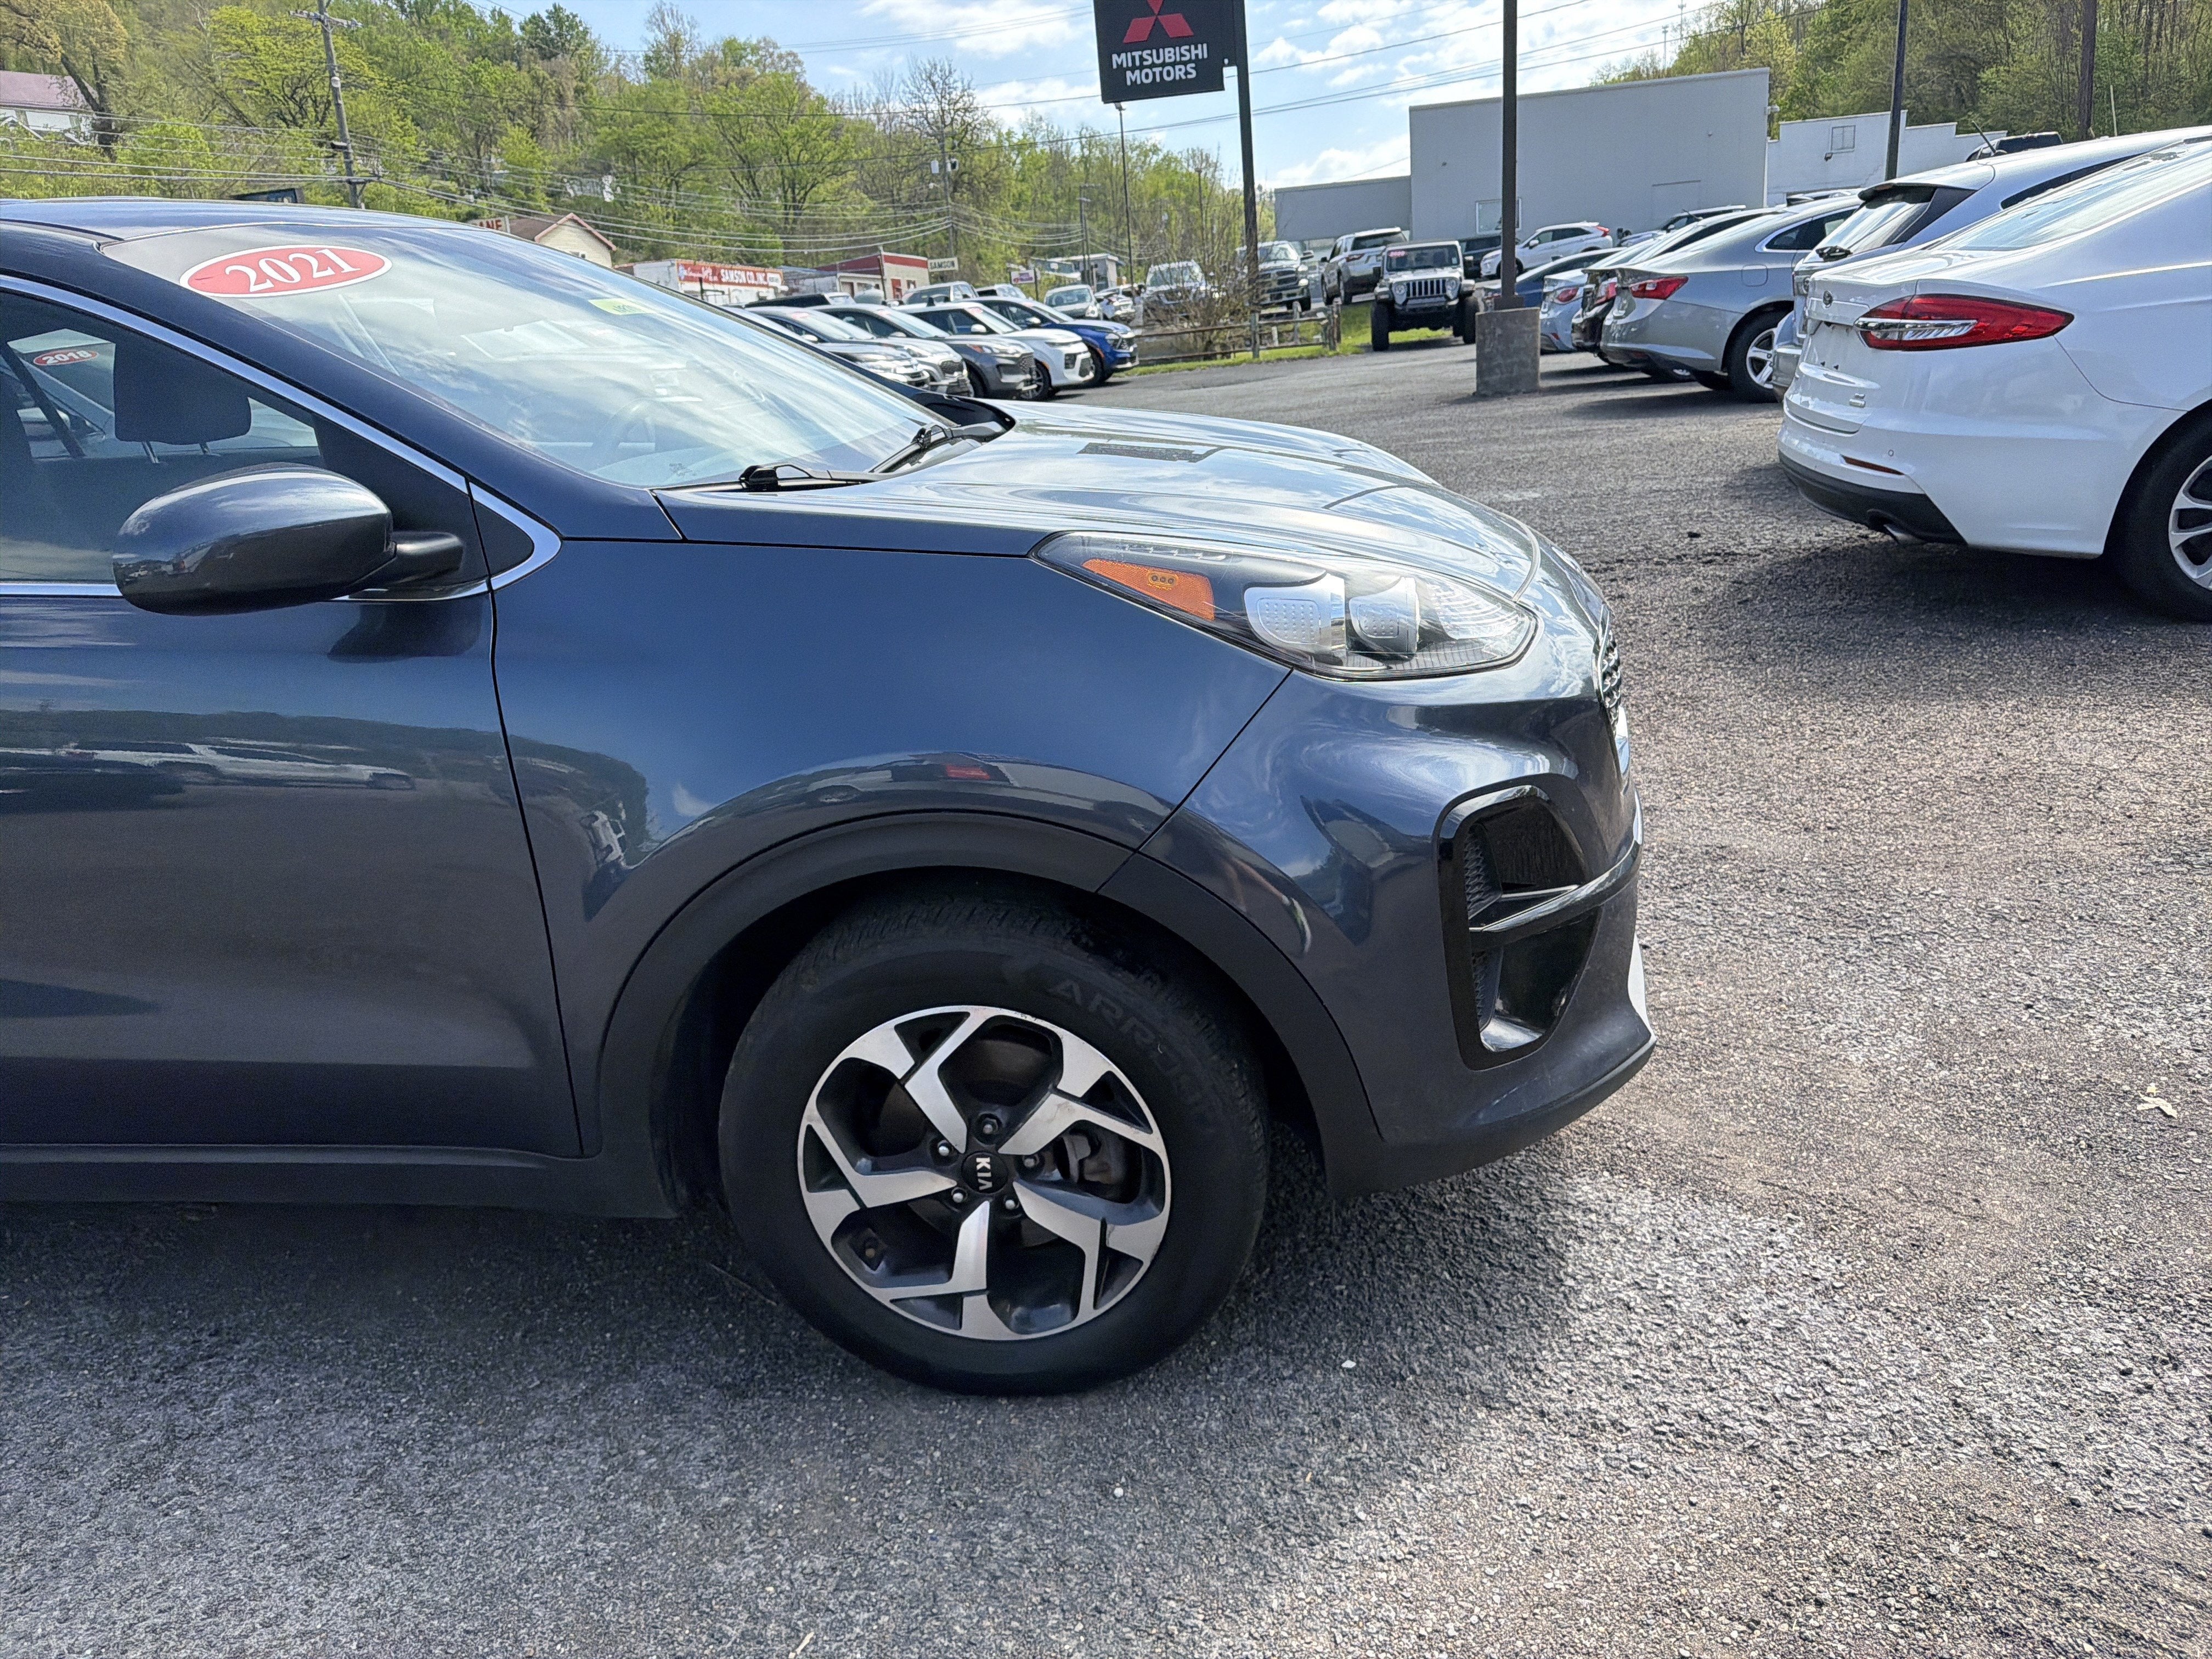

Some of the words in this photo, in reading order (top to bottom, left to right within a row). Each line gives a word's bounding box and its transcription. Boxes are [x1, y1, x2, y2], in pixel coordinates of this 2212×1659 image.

[1112, 43, 1207, 69] MITSUBISHI
[1126, 63, 1197, 86] MOTORS
[225, 249, 360, 292] 2021
[42, 351, 92, 364] 2018
[976, 1157, 992, 1190] KIA
